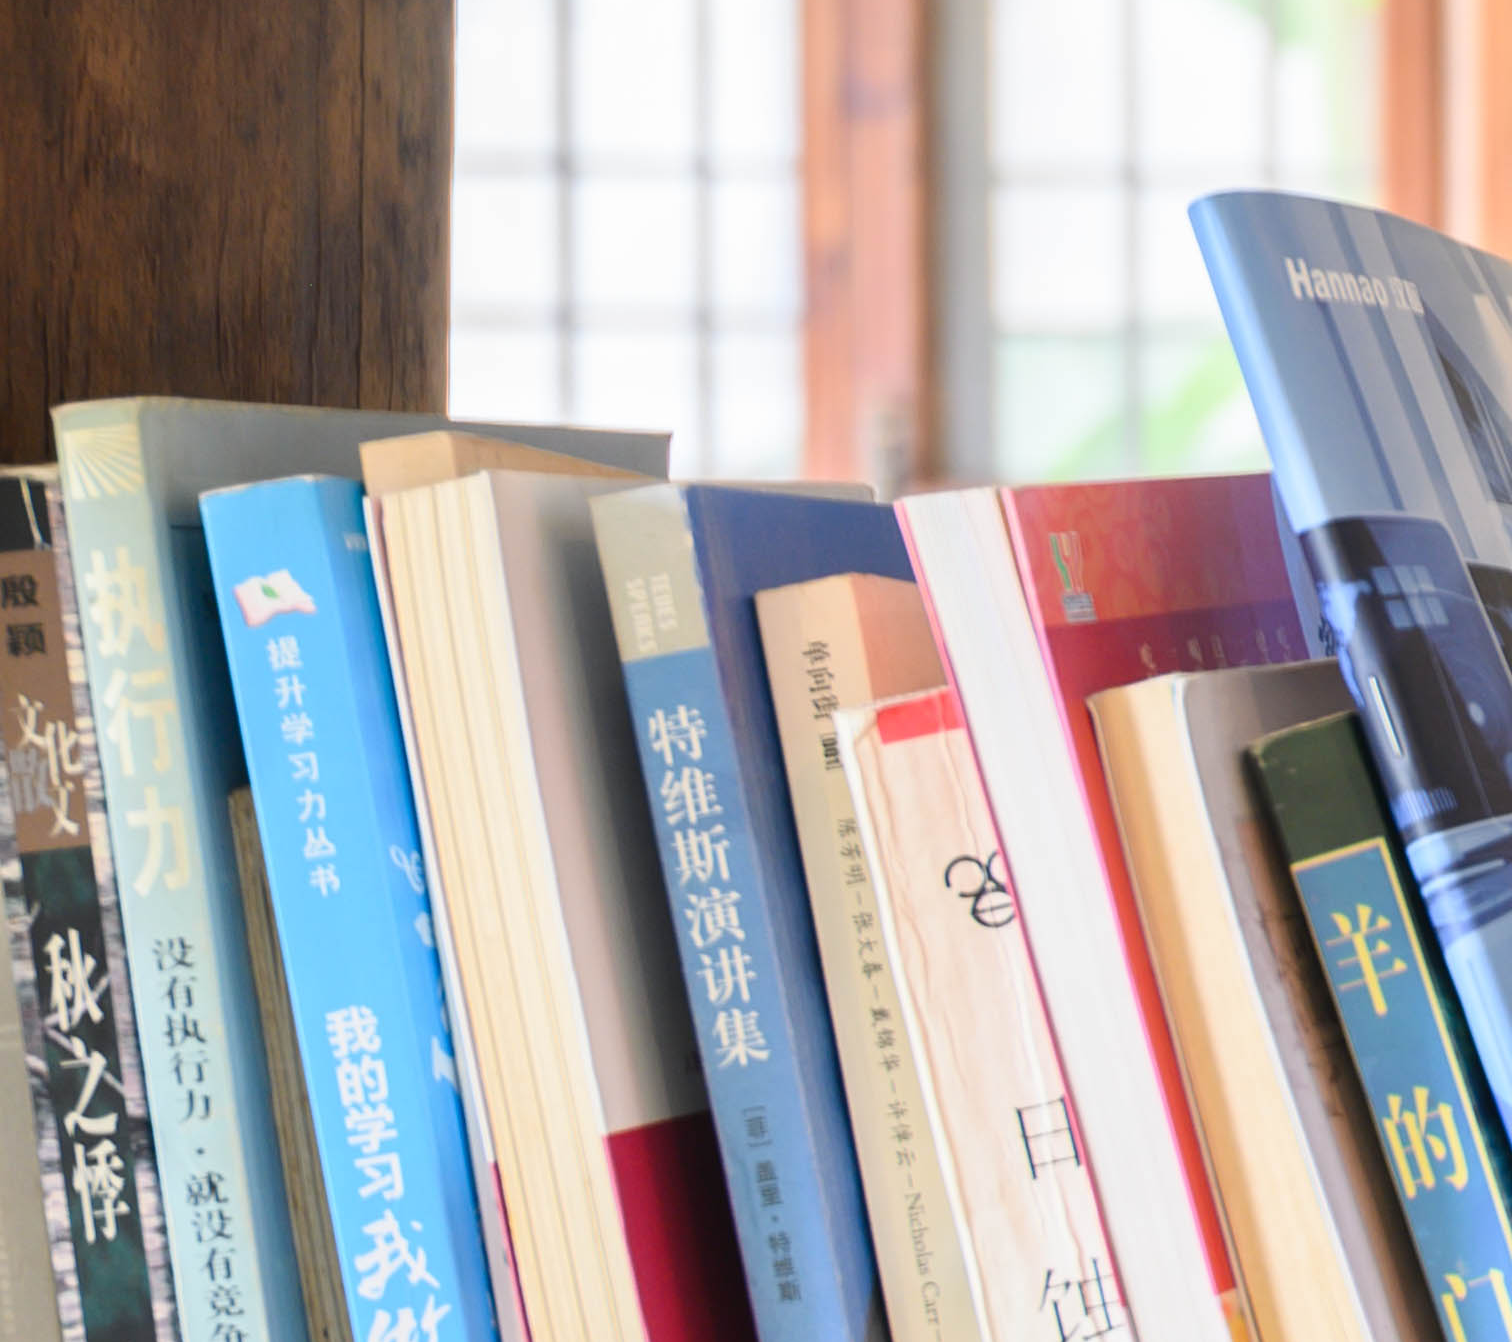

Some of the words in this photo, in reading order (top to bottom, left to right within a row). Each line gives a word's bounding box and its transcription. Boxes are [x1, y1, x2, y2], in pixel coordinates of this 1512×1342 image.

[1285, 257, 1389, 307] Hannao
[84, 546, 192, 897] 执行力
[266, 636, 340, 896] 提升学习力丛书
[647, 705, 770, 1069] 特维斯演讲集
